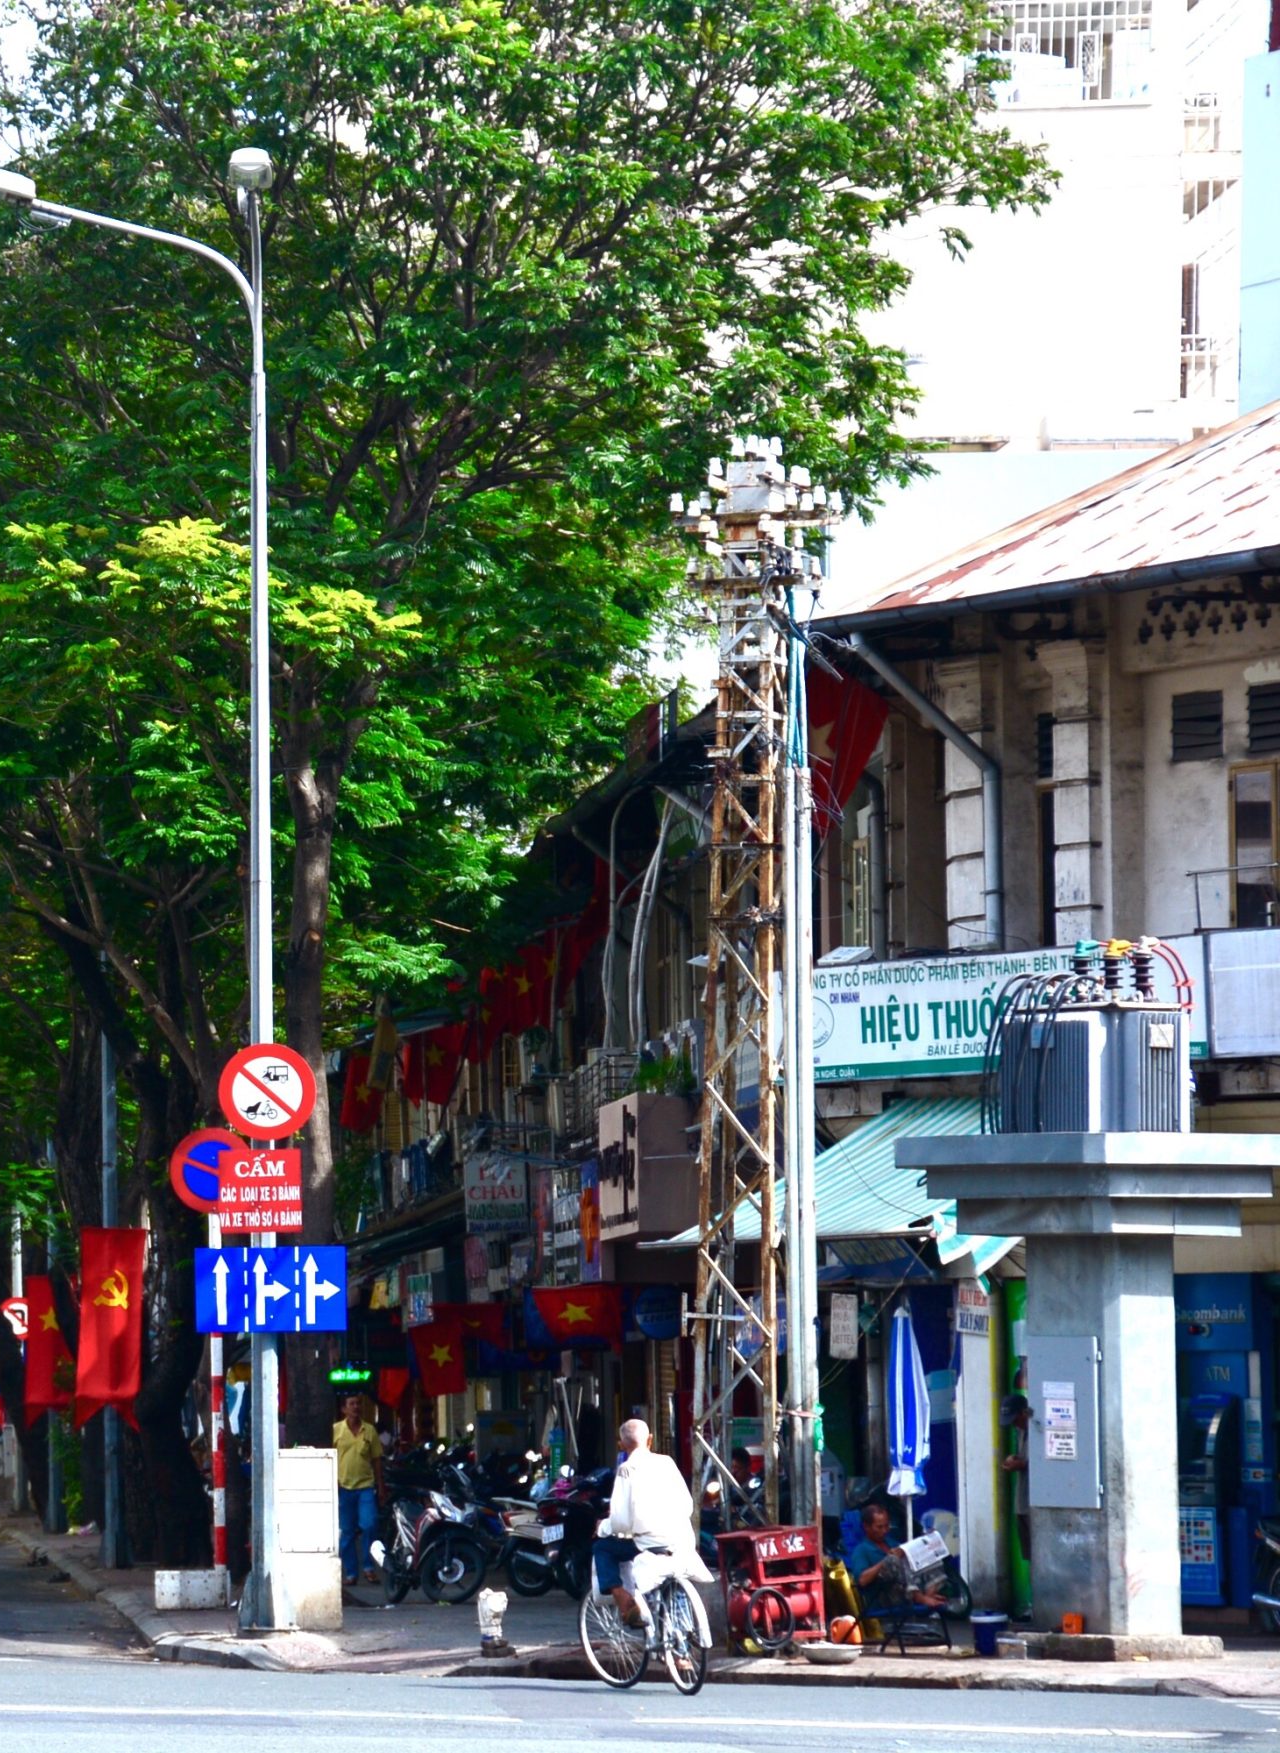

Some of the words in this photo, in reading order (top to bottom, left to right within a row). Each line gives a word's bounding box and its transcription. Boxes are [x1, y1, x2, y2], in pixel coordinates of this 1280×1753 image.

[829, 972, 842, 988] TY
[860, 994, 920, 1050] HIỆU
[234, 1153, 286, 1178] CẤM
[221, 1183, 237, 1203] CÁC
[240, 1186, 259, 1206] LOẠI
[260, 1186, 271, 1201] XE
[278, 1182, 300, 1201] BÁNH
[232, 1212, 243, 1227] XE
[280, 1207, 303, 1226] BÁNH
[785, 1536, 805, 1554] XE
